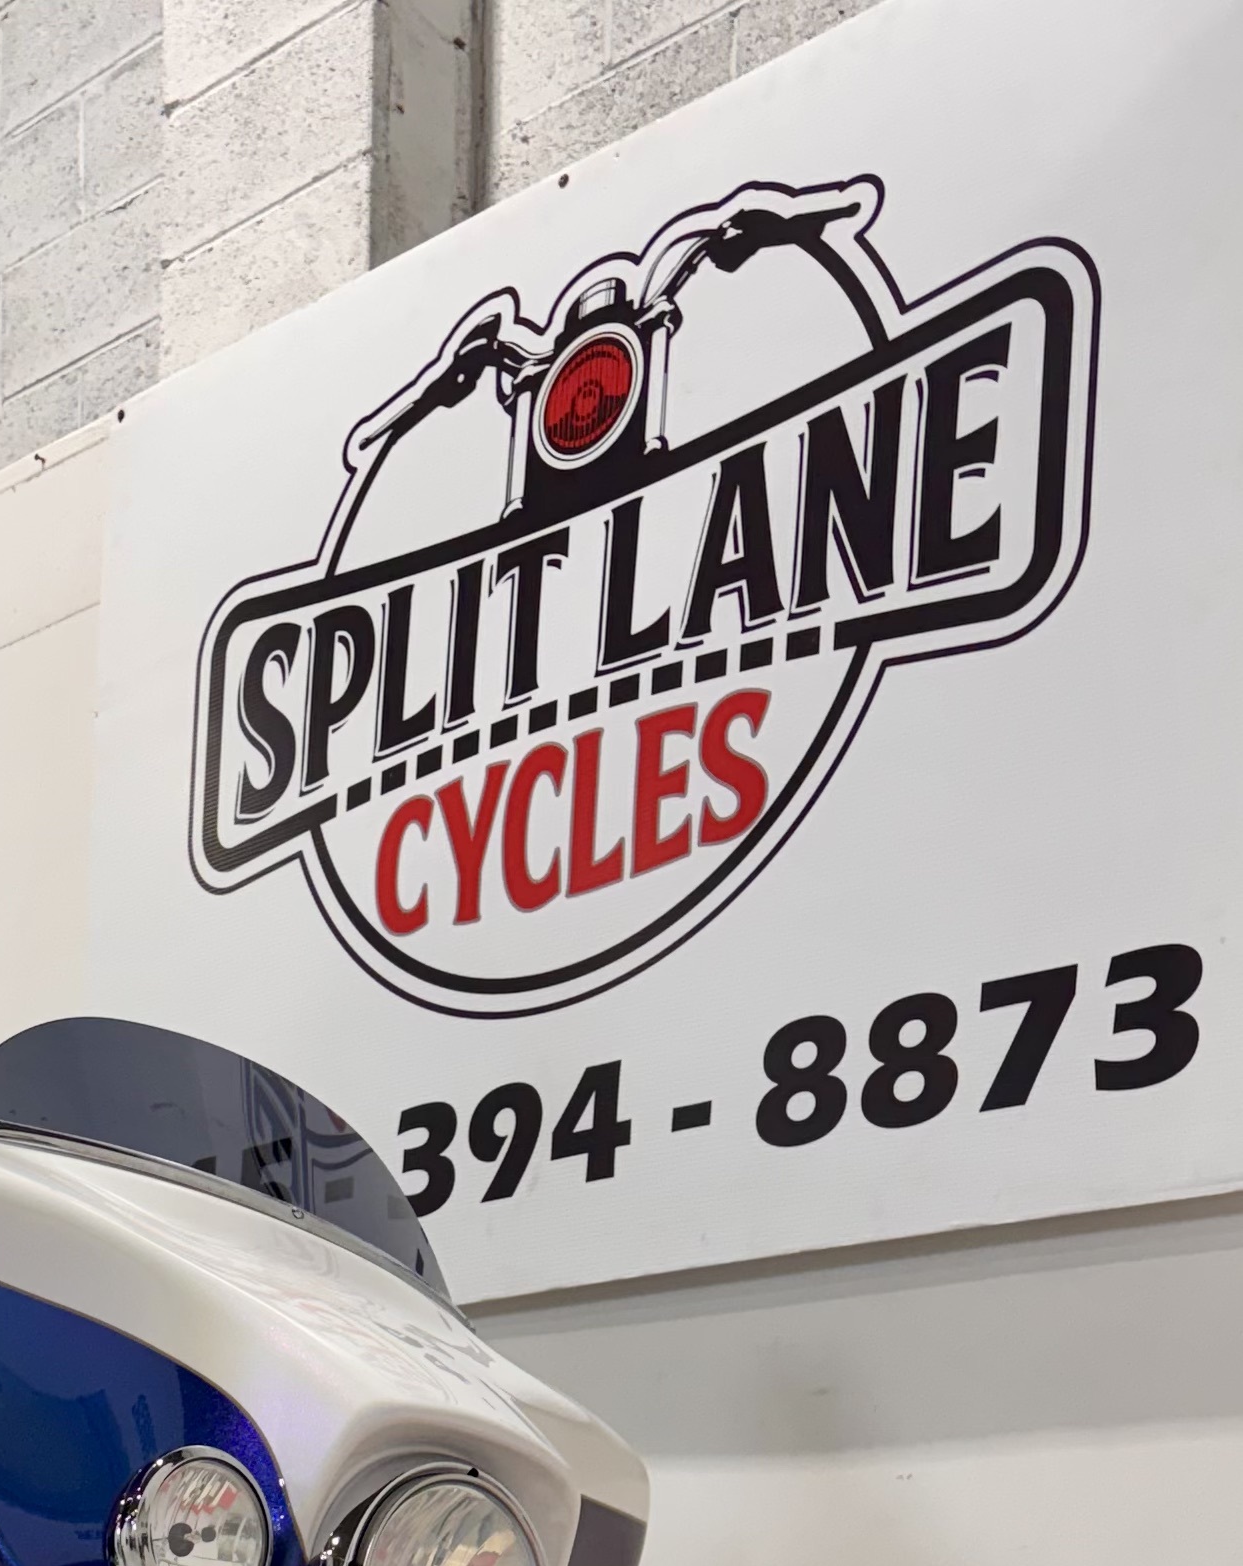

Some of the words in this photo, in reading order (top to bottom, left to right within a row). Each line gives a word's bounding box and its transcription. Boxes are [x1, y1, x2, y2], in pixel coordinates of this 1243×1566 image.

[234, 526, 570, 826] SPLIT
[595, 321, 1013, 677] LANE
[373, 687, 772, 936] CYCLES
[397, 1059, 632, 1218] 394
[755, 942, 1204, 1148] 8873
